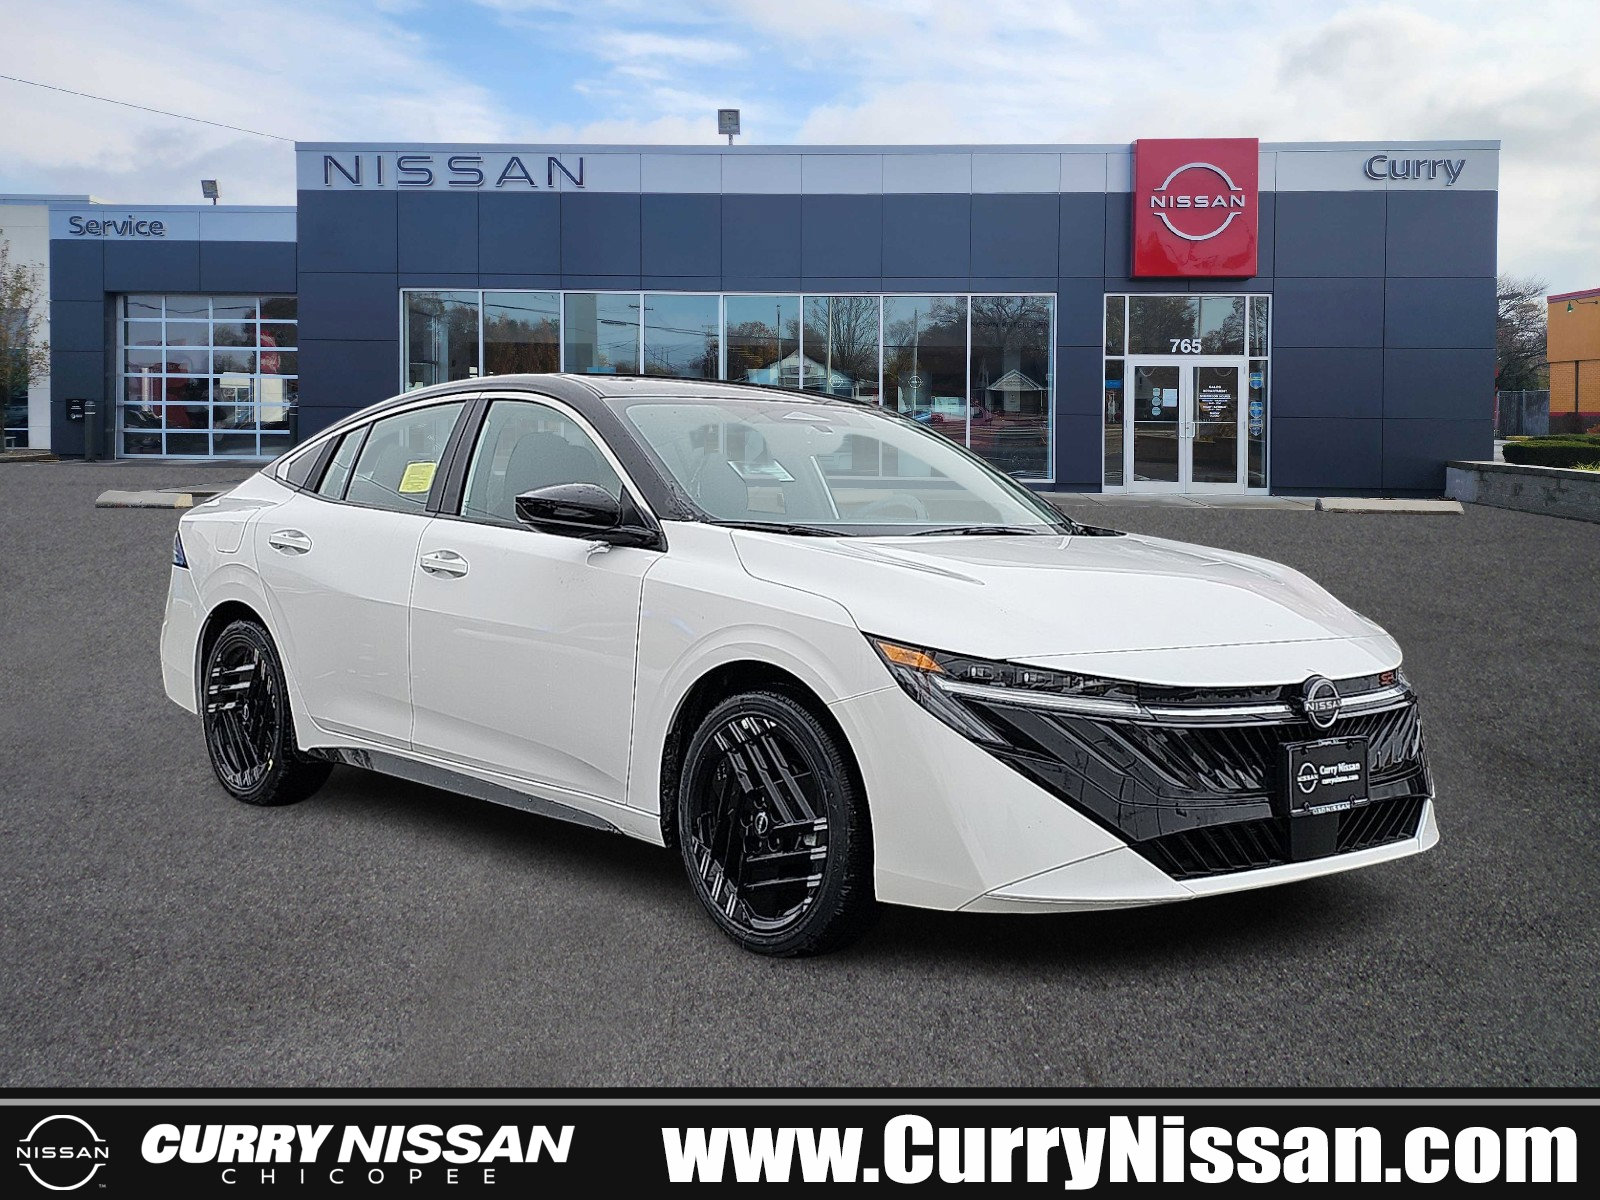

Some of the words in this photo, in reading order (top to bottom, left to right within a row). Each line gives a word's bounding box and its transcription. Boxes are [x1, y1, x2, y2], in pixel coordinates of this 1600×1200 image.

[323, 155, 585, 188] NISSAN
[1365, 155, 1466, 186] Curry
[1150, 195, 1246, 208] NISSAN
[69, 214, 165, 236] Service
[1169, 338, 1202, 354] 765
[1305, 698, 1342, 712] NISSAN
[1319, 765, 1338, 776] Curry
[1338, 762, 1361, 773] Nissan
